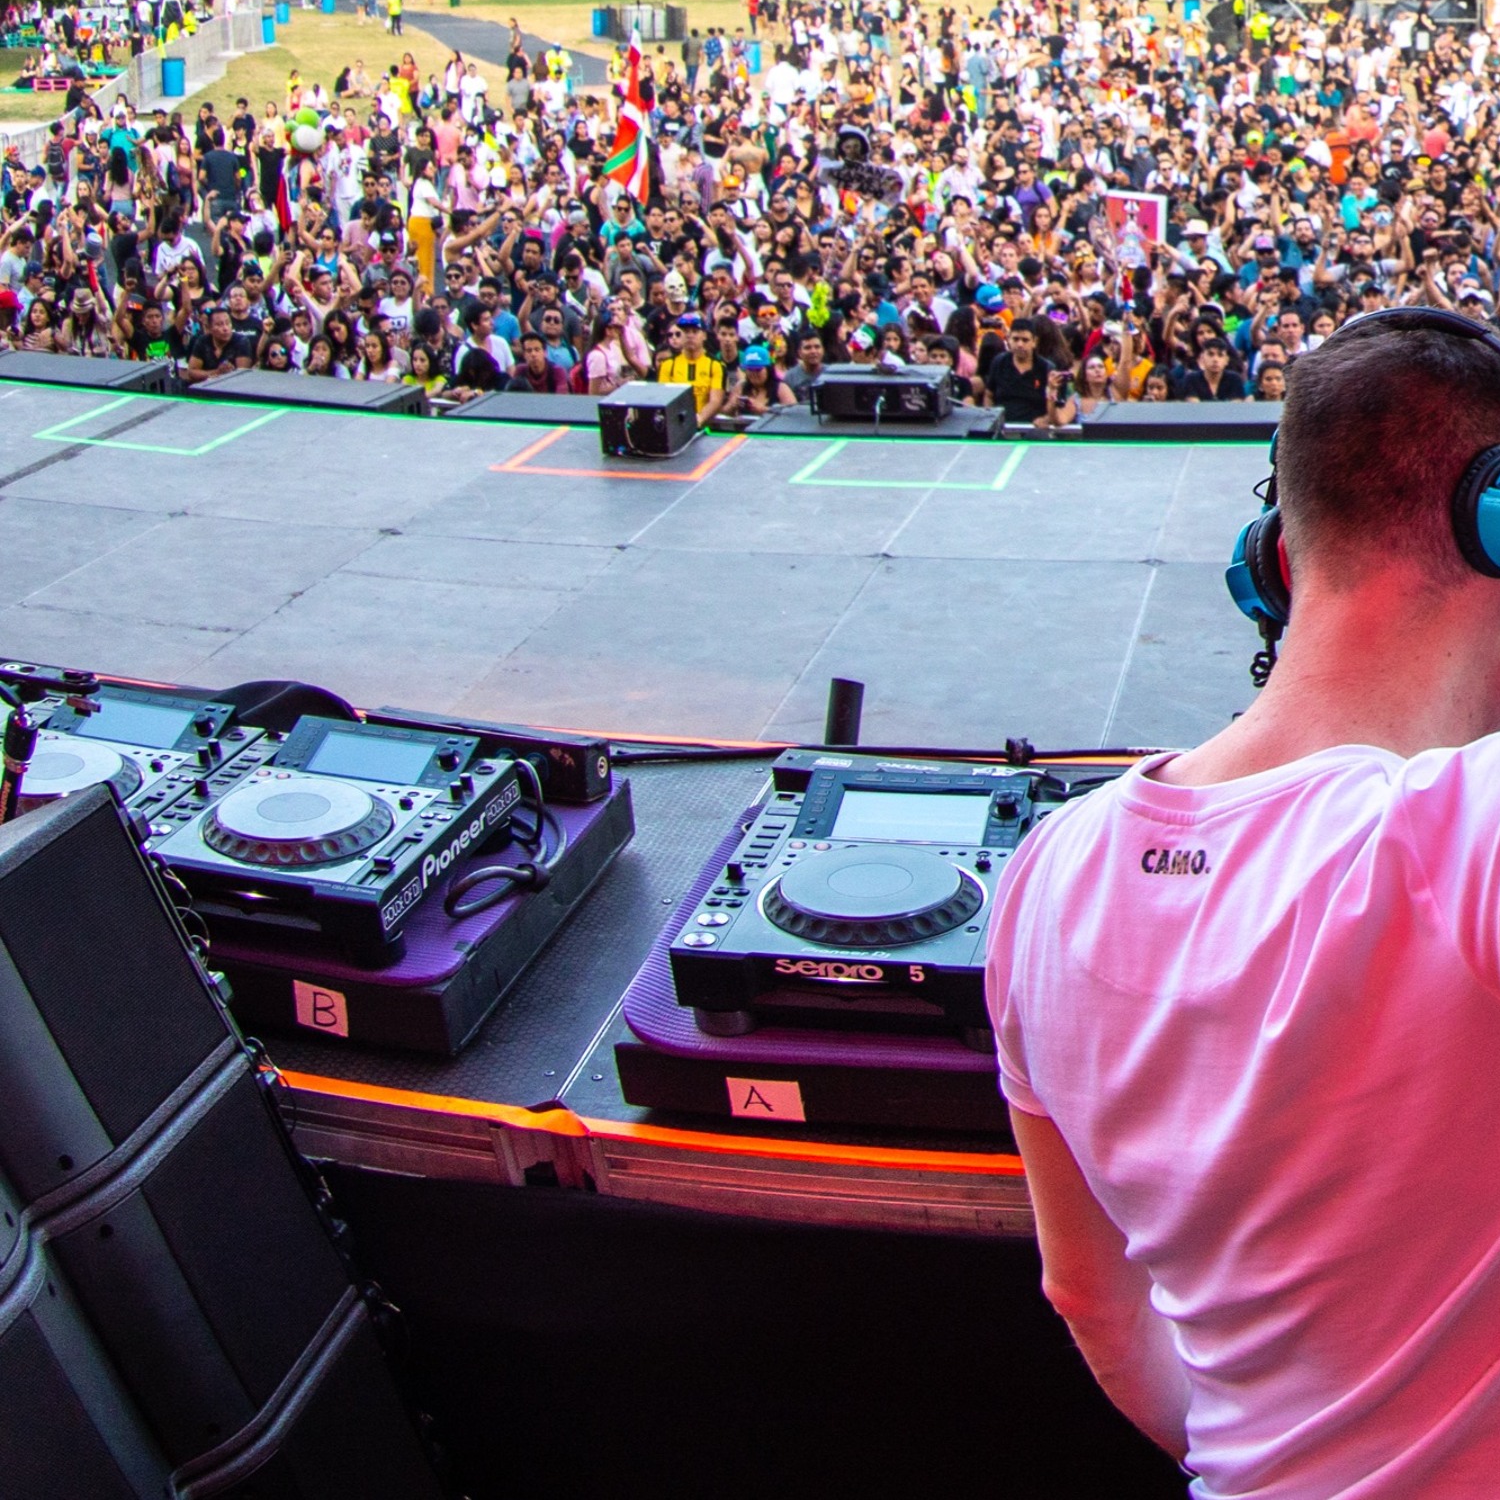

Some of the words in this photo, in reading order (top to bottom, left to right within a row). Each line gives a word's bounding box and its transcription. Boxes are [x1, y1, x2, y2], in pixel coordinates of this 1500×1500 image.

[422, 810, 487, 890] Pioneer
[1141, 848, 1212, 876] CAMO.
[774, 958, 884, 980] serpro
[909, 965, 925, 982] 5
[313, 991, 337, 1027] B
[742, 1085, 774, 1113] A
